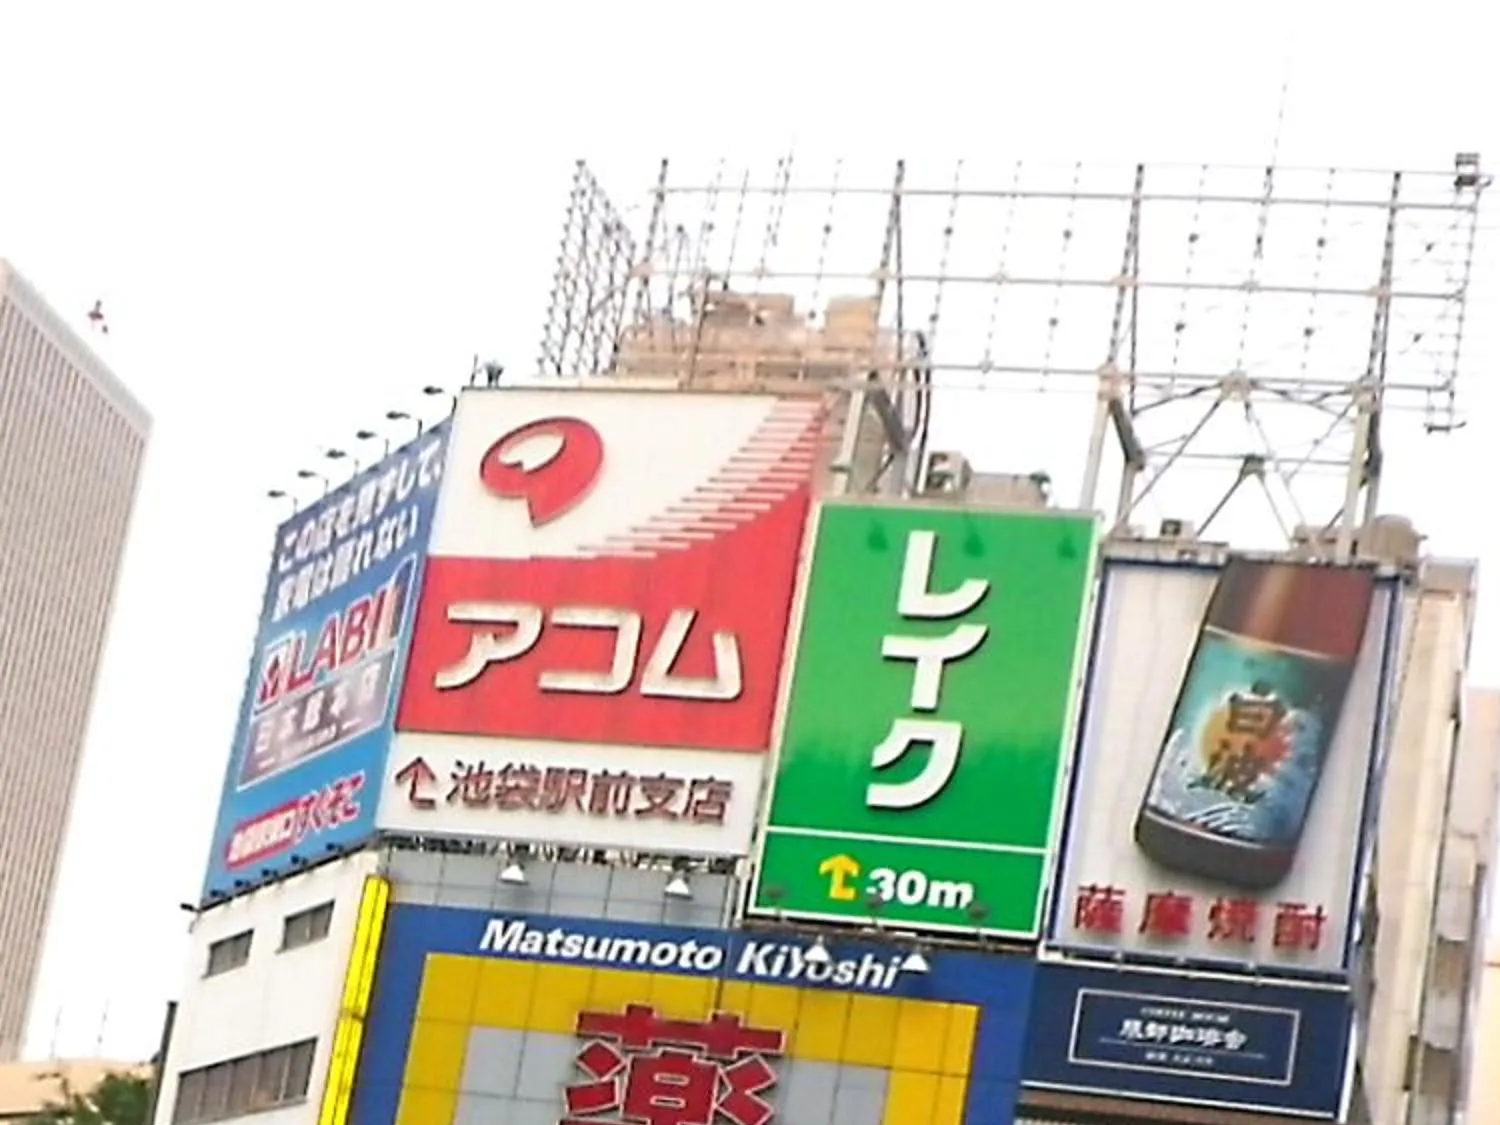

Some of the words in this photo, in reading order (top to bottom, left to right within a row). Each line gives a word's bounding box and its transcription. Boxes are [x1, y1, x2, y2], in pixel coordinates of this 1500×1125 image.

[433, 601, 745, 702] アコム
[866, 529, 990, 809] レイク
[449, 757, 735, 826] 池袋駅前支店
[868, 867, 975, 912] 30m
[1070, 884, 1329, 953] 薩摩焼酎
[479, 918, 724, 973] Matsumoto
[737, 940, 906, 992] Kiyoshi
